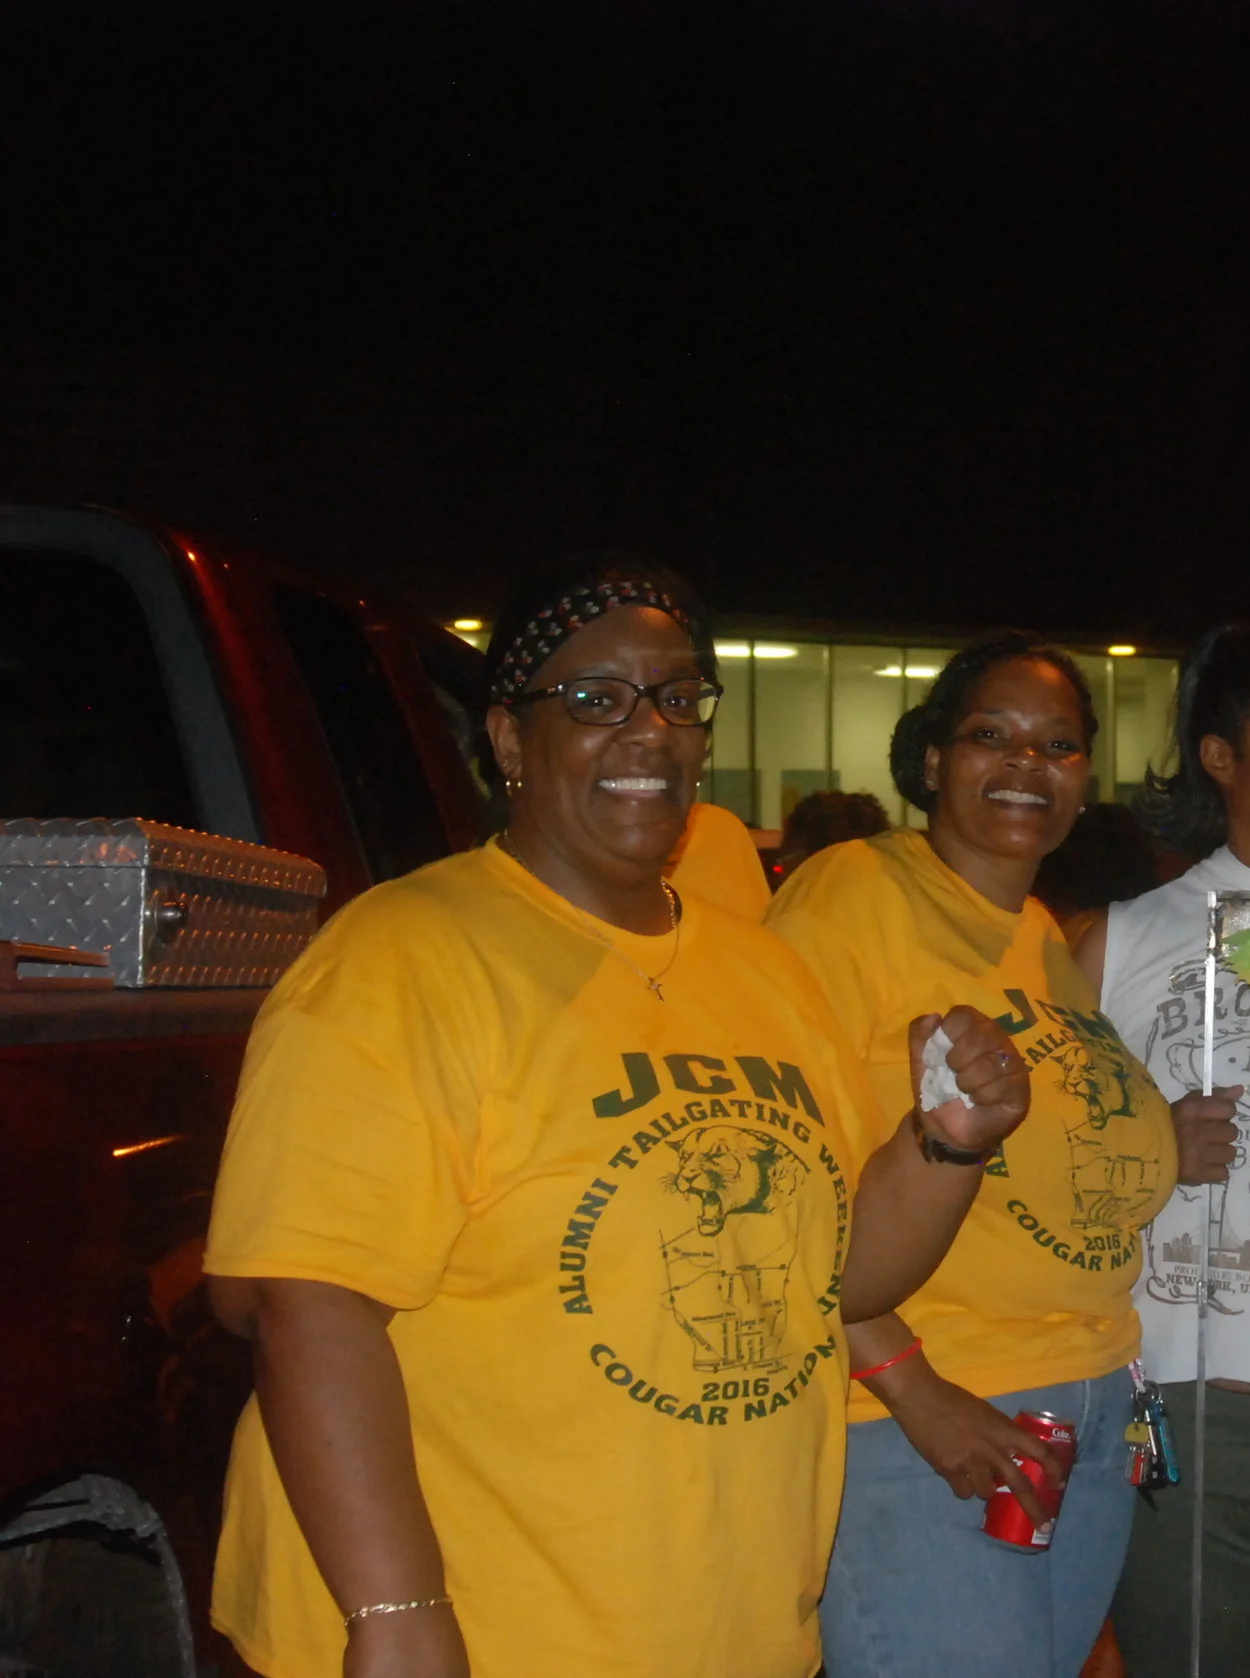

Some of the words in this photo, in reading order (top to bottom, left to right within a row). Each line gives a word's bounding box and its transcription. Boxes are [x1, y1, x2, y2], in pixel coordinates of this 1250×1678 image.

[591, 1052, 825, 1129] JCM
[558, 1177, 618, 1317] ALUMNI
[608, 1098, 812, 1170] TAILGATING
[1007, 1199, 1104, 1272] COUGAR
[1110, 1231, 1138, 1270] NAT
[1083, 1233, 1121, 1252] 2016
[1165, 1272, 1197, 1287] NEW
[590, 1342, 729, 1427] COUGAR
[743, 1334, 838, 1423] NATION
[701, 1377, 771, 1403] 2016
